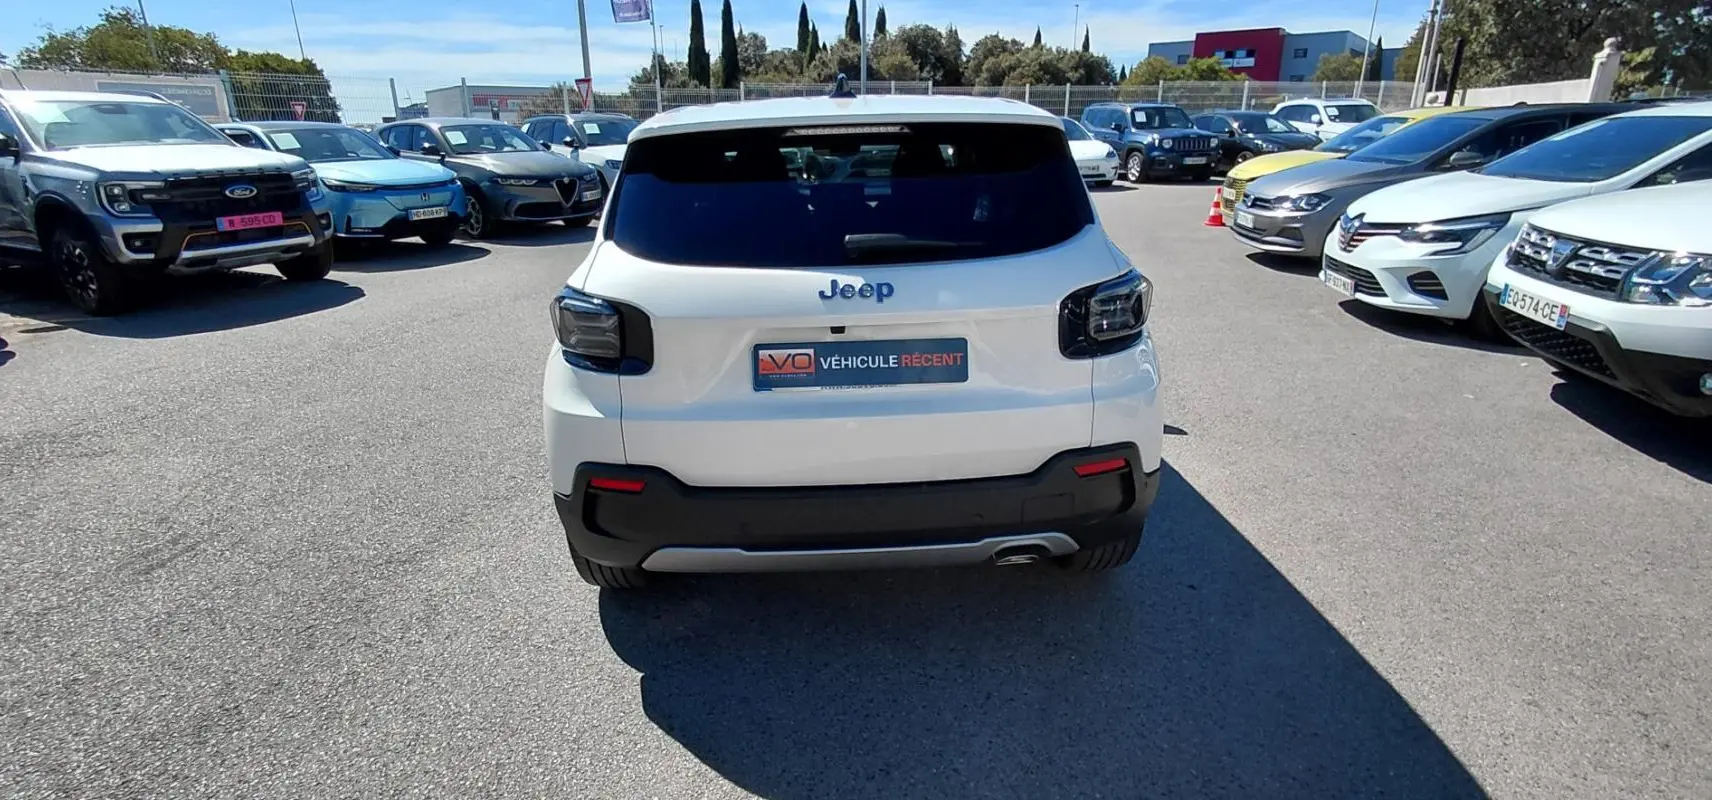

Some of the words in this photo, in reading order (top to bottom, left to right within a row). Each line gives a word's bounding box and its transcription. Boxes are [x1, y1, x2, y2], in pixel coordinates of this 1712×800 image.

[818, 279, 895, 304] Jeep
[1506, 288, 1560, 323] EQ-574-CE
[820, 353, 899, 370] VÉHICULE
[901, 352, 964, 368] RÉCENT
